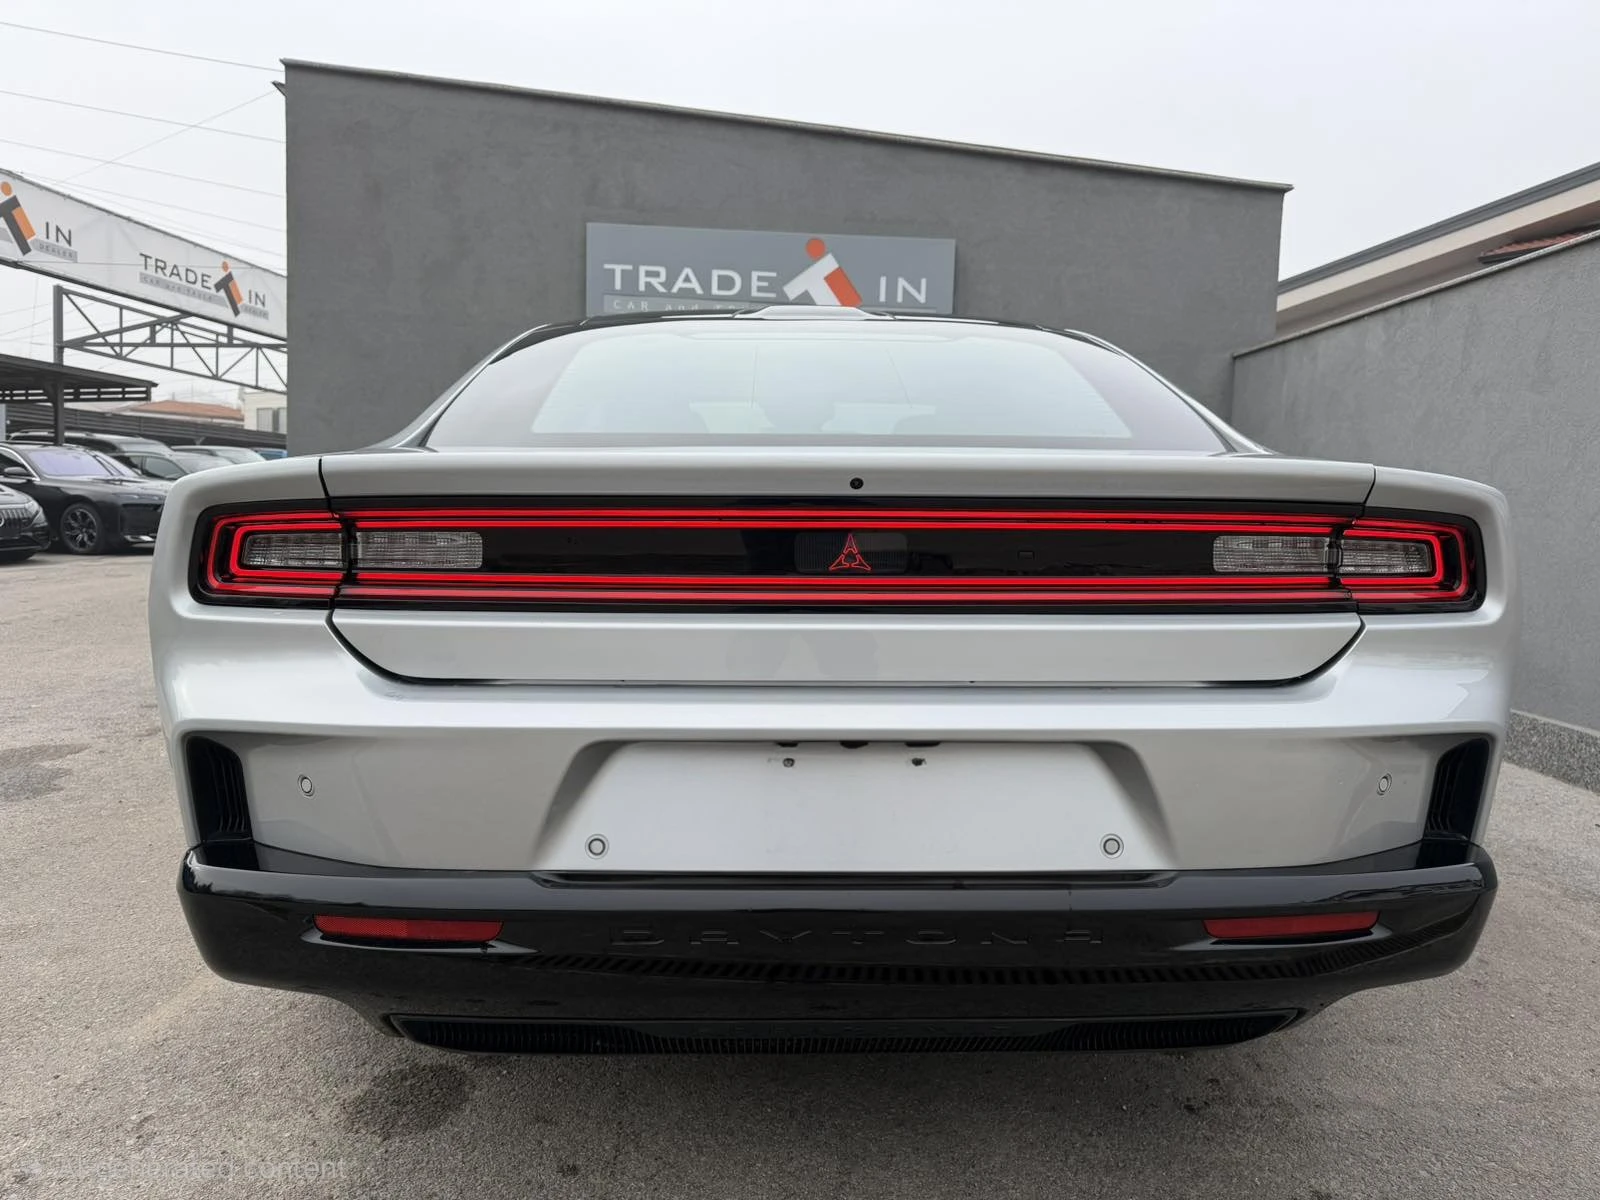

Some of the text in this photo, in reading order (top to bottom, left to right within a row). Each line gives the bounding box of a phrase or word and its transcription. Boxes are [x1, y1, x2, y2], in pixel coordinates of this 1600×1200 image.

[45, 221, 72, 247] IN
[139, 253, 266, 308] TRADE IN
[603, 263, 927, 304] TRADE IN
[613, 299, 649, 312] CAR
[610, 929, 1104, 946] DAYTONA
